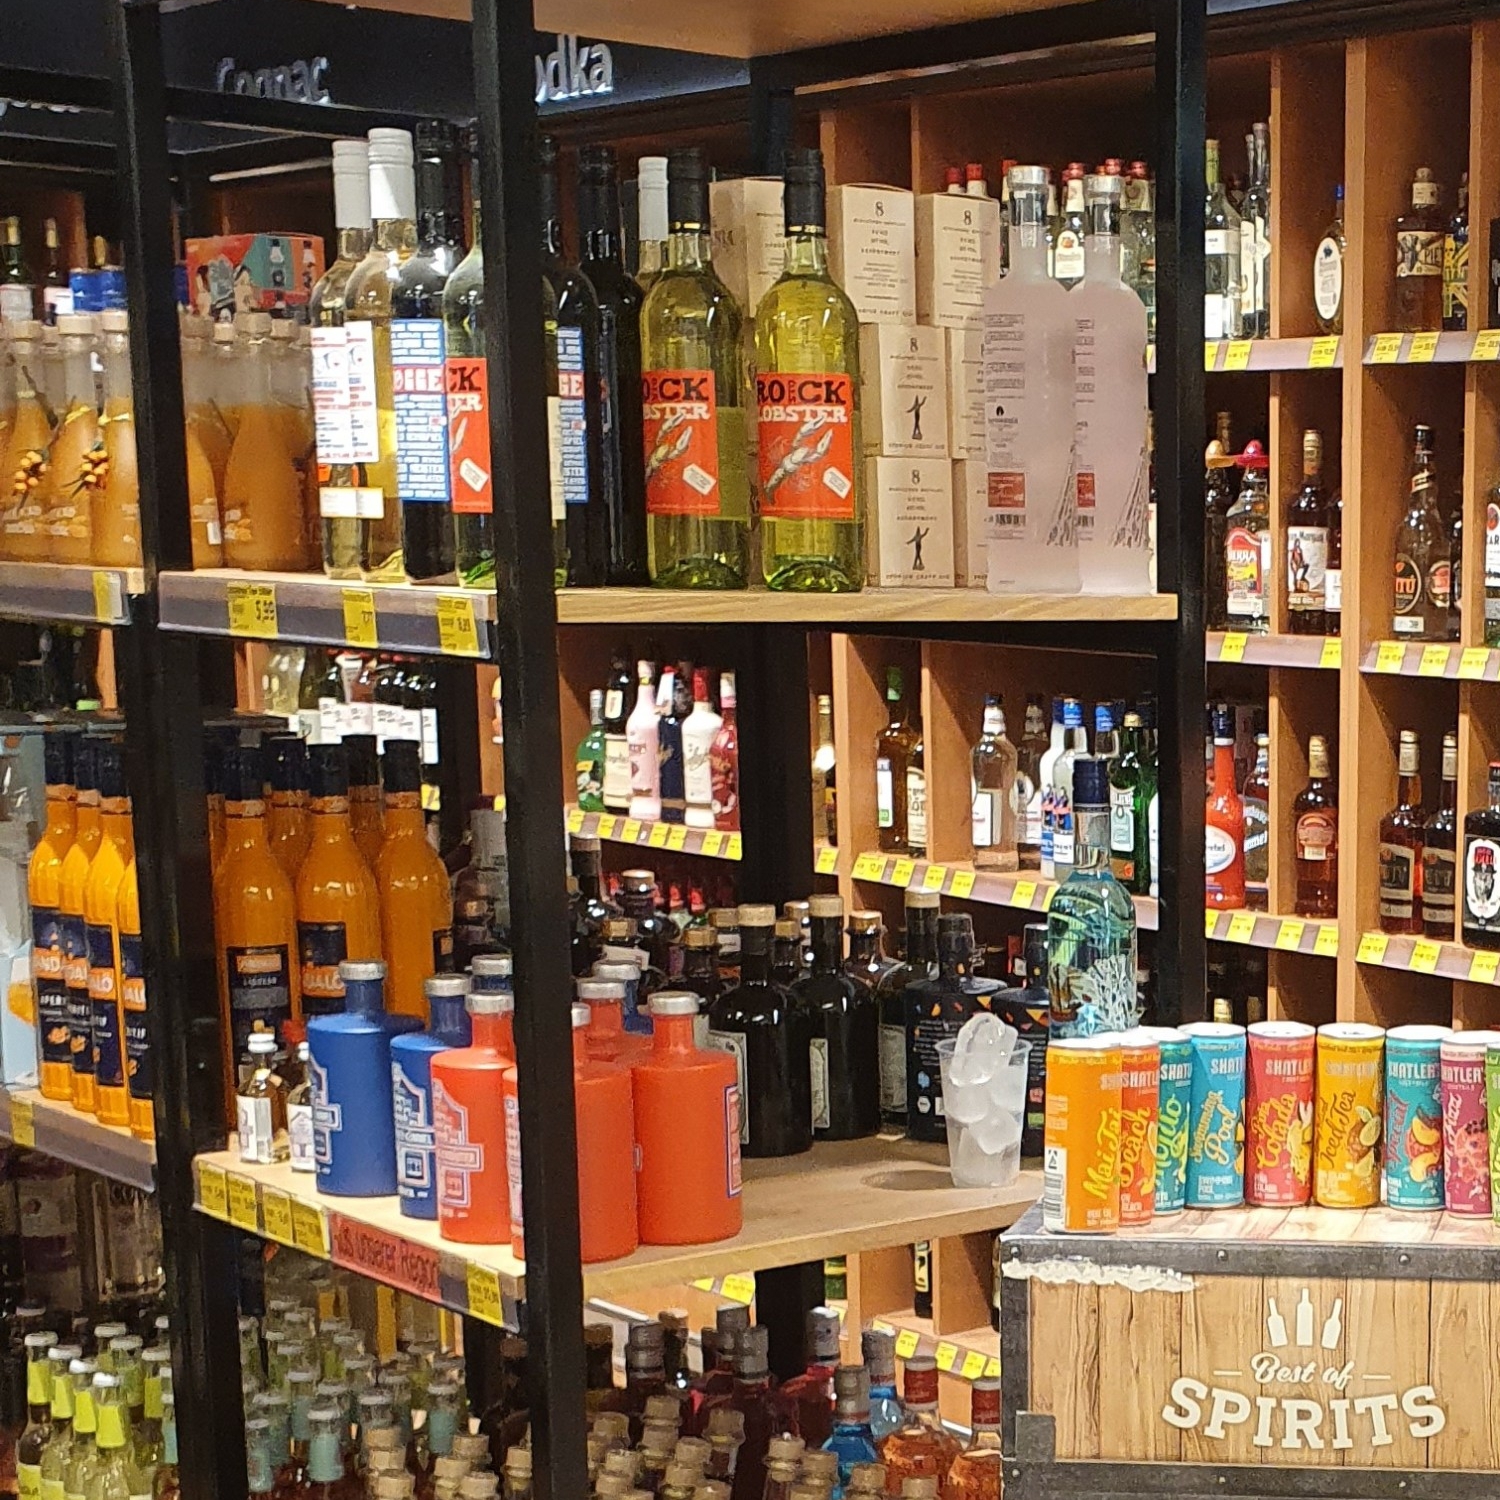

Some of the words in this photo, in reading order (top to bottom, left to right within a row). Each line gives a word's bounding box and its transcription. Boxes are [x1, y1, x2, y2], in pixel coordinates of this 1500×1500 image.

[535, 32, 614, 103] dka
[875, 201, 885, 217] 8
[963, 210, 973, 226] 8
[450, 366, 482, 393] CK
[642, 377, 709, 402] OCK
[643, 402, 711, 421] STER
[1204, 1102, 1237, 1166] Pool
[1256, 1091, 1298, 1169] Colada
[1250, 1351, 1316, 1385] Best
[1321, 1360, 1356, 1390] of
[1161, 1379, 1447, 1450] SPIRITS
